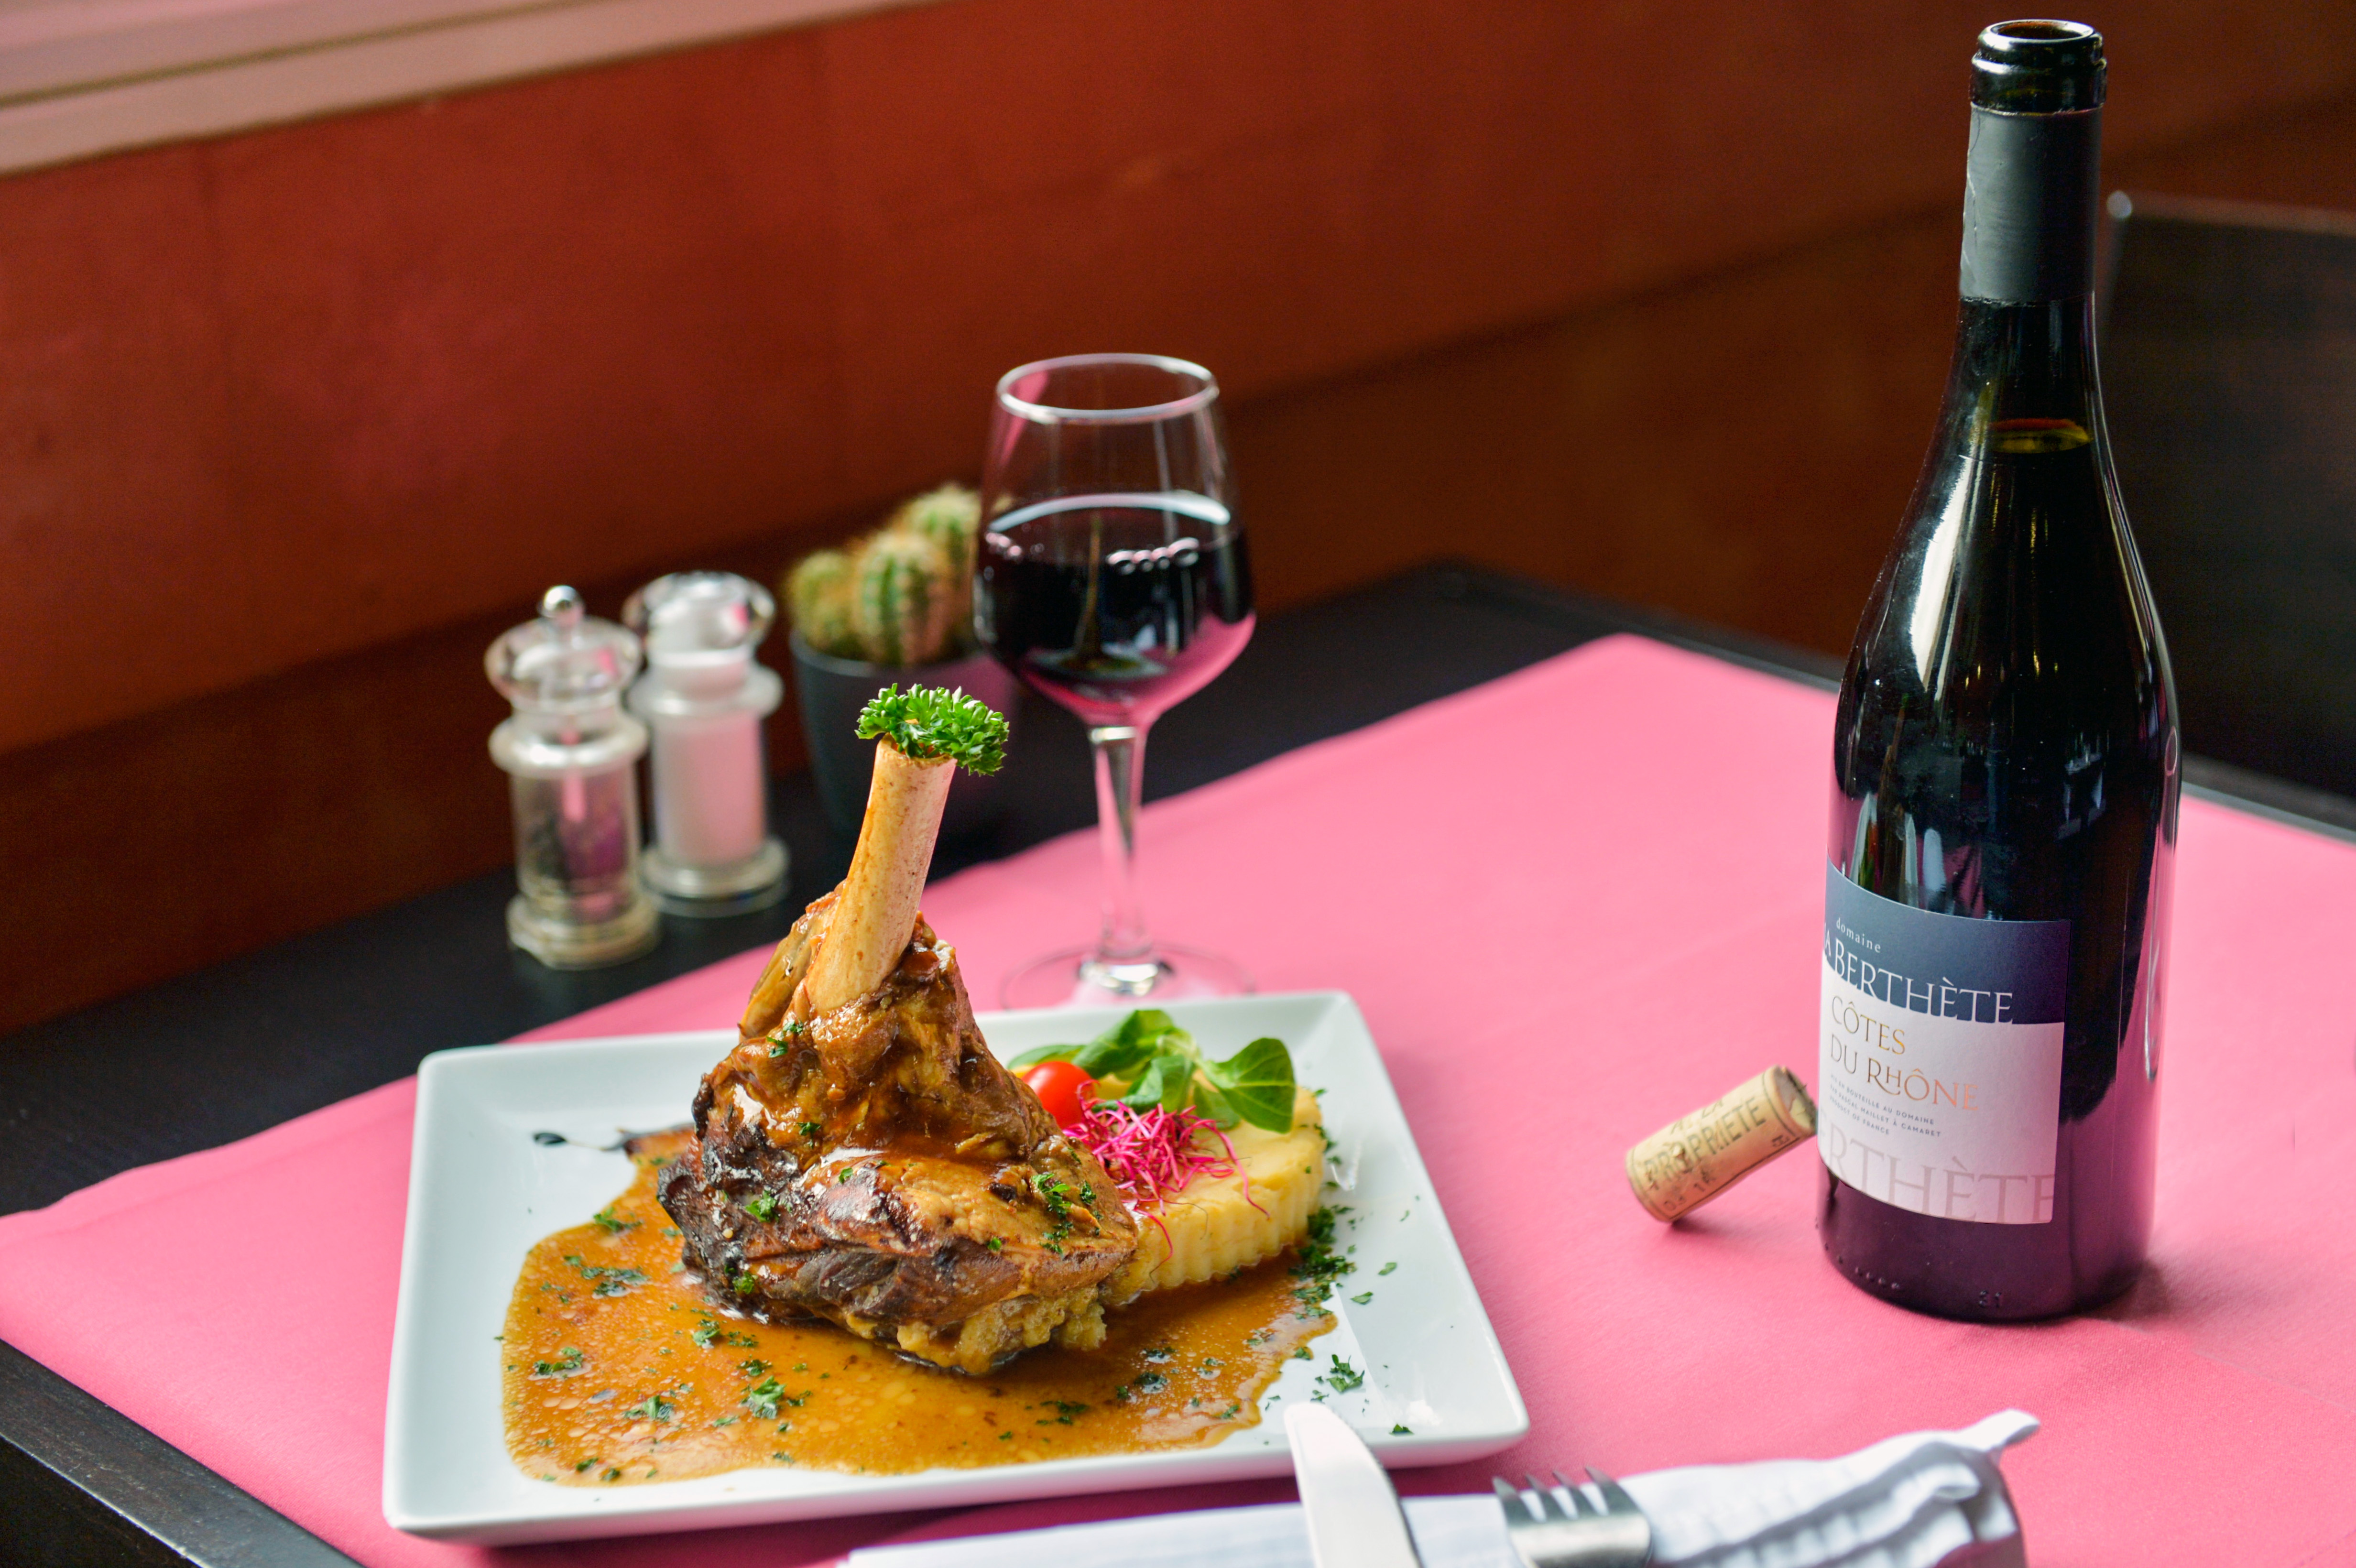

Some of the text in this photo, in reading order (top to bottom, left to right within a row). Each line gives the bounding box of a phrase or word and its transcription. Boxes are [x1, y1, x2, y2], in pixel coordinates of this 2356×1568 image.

[1836, 917, 1881, 953] domaine
[1834, 937, 2013, 1024] BERTHÈTE
[1832, 996, 1905, 1055] CÔTES
[1831, 1034, 1979, 1111] DU RHÔNE
[1846, 1087, 1879, 1109] BOUTEILLE
[1883, 1106, 1892, 1114] AU
[1896, 1110, 1934, 1125] DOMAINE
[1861, 1107, 1889, 1123] MAILLET
[1901, 1122, 1942, 1137] CAMARET
[1862, 1118, 1890, 1135] FRANCE
